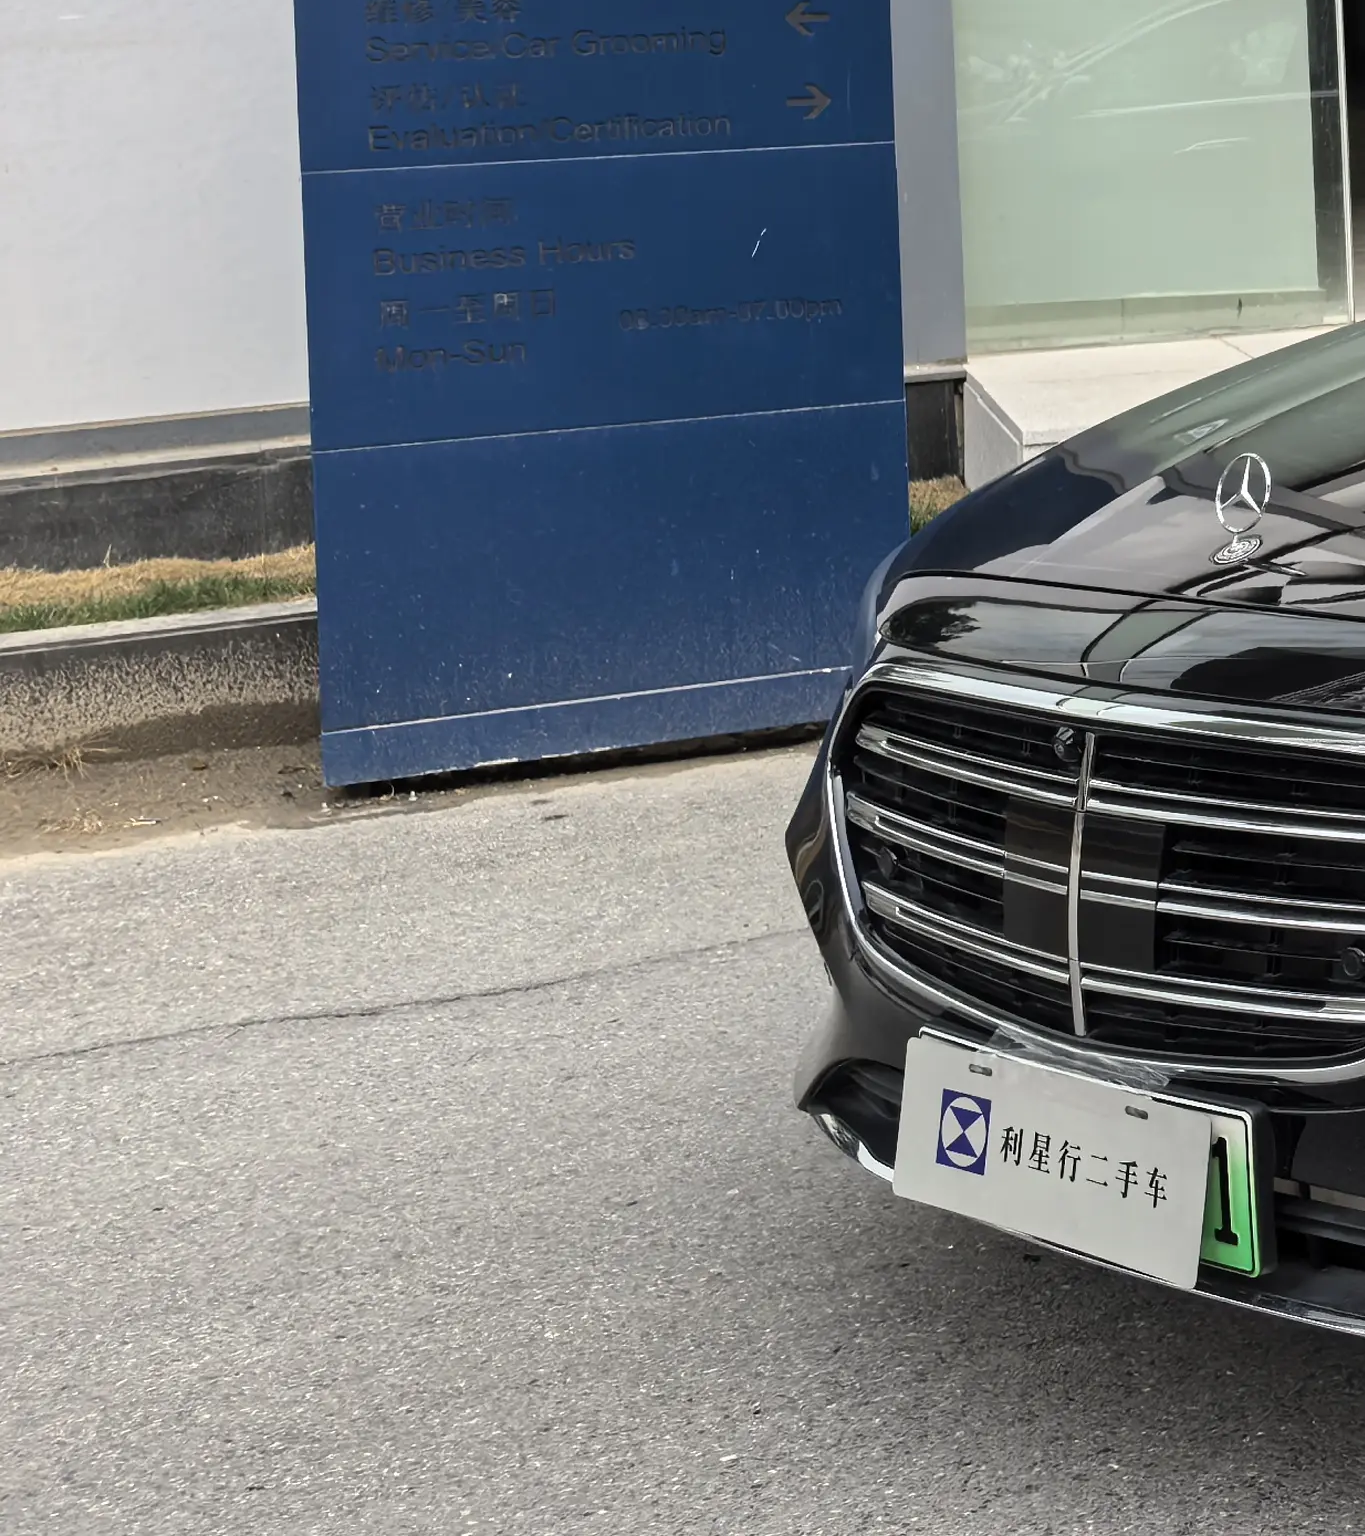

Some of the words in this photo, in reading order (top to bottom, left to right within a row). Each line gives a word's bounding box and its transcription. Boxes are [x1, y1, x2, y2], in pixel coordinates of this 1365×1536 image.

[572, 26, 728, 58] Grooming
[373, 245, 525, 277] Business
[537, 238, 636, 267] Hours
[375, 339, 526, 373] Mon-Sun
[1000, 1126, 1168, 1209] 利星行二手车
[1212, 1136, 1239, 1246] 1
